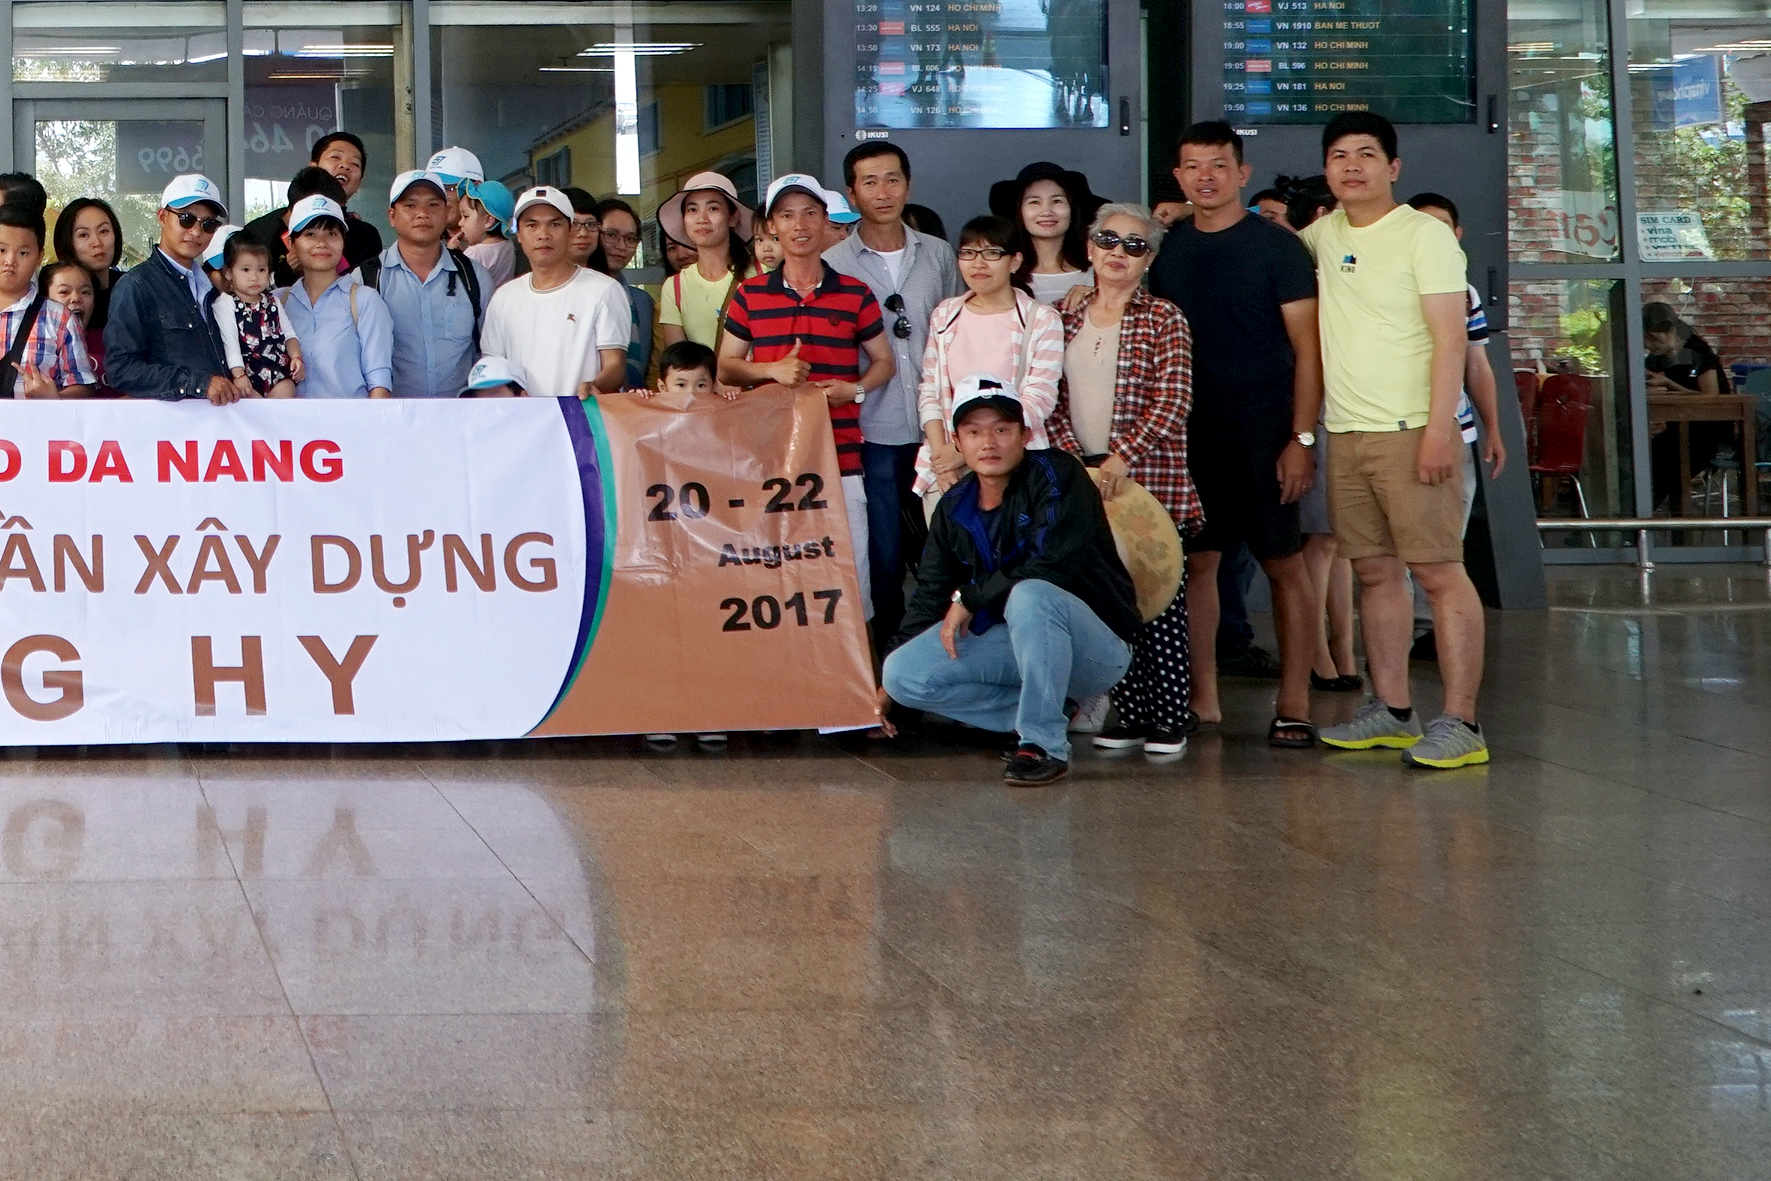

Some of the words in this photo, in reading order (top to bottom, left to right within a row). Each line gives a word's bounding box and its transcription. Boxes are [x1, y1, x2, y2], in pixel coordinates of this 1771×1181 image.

[1223, 2, 1245, 10] 18:00
[1278, 2, 1289, 10] VJ
[1292, 2, 1307, 10] 513
[1314, 2, 1327, 10] HA
[1329, 2, 1345, 10] NOI
[1223, 62, 1245, 70] 19:05
[1278, 62, 1289, 70] BL
[1292, 62, 1306, 70] 596
[1314, 62, 1328, 70] HO
[1329, 62, 1345, 70] CHI
[1346, 62, 1368, 70] MINH
[867, 131, 889, 139] IKUSI
[1640, 216, 1660, 224] SIM
[1663, 216, 1691, 224] CARD
[48, 439, 134, 483] DA
[156, 439, 345, 483] NANG
[645, 482, 711, 522] 20
[761, 473, 828, 513] 22
[133, 516, 280, 595] XÂY
[311, 530, 559, 609] DỰNG
[718, 535, 836, 569] August
[719, 588, 843, 632] 2017
[192, 634, 380, 717] HY
